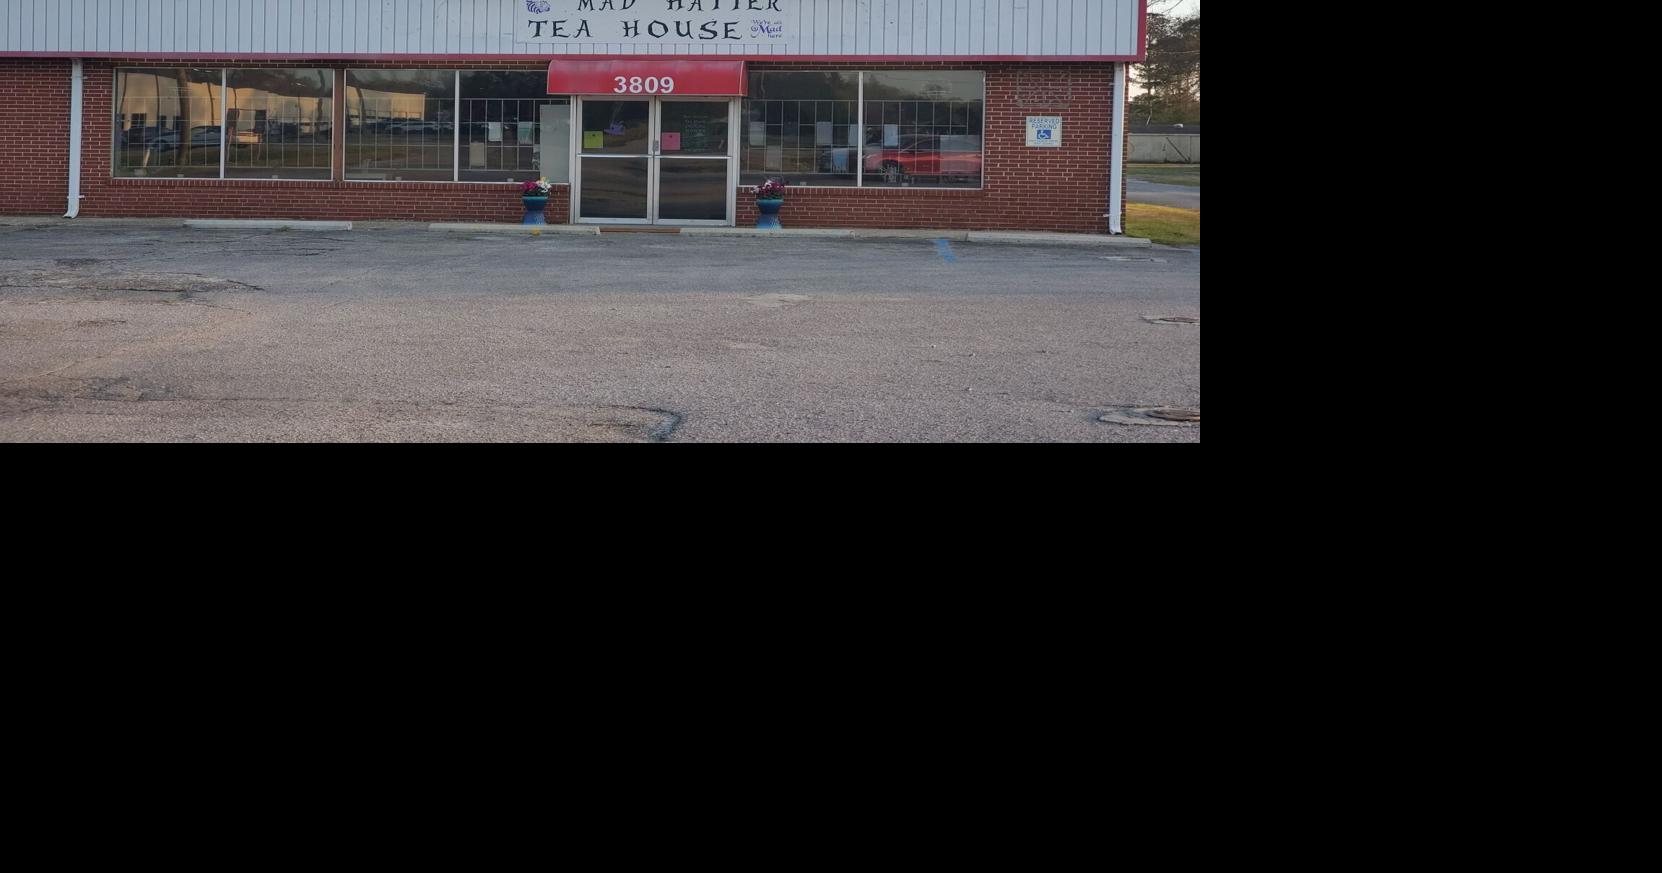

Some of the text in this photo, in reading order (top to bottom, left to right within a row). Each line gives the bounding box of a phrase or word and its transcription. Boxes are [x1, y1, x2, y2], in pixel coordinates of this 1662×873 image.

[528, 19, 743, 39] TEA HOUSE
[751, 24, 782, 35] Mad
[613, 76, 675, 94] 3809
